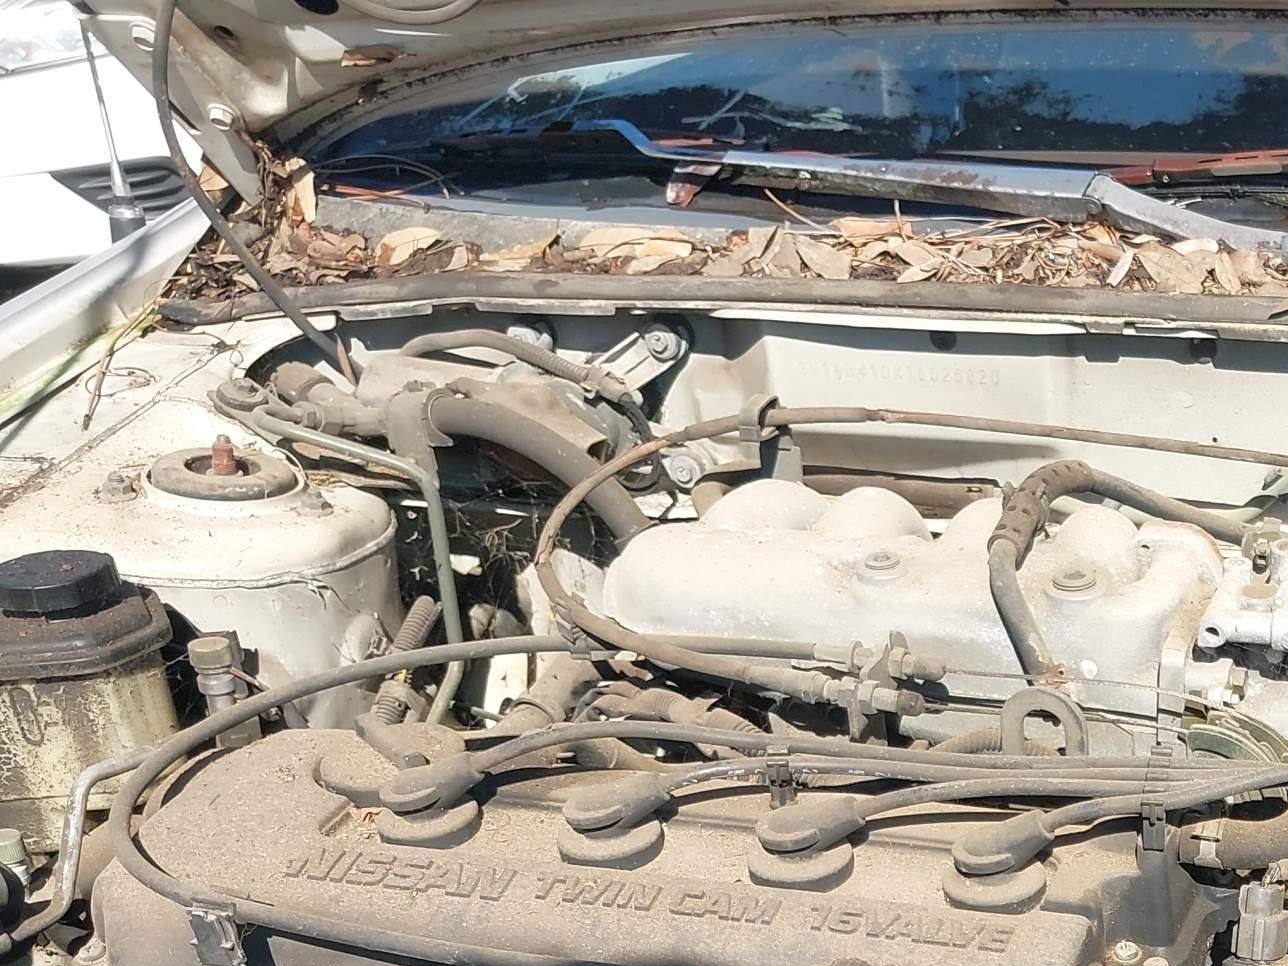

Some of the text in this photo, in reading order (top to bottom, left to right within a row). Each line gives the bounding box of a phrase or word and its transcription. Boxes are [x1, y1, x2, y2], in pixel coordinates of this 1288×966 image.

[285, 847, 518, 900] NISSAN
[535, 875, 663, 912] TWIN
[669, 890, 781, 926] CAM
